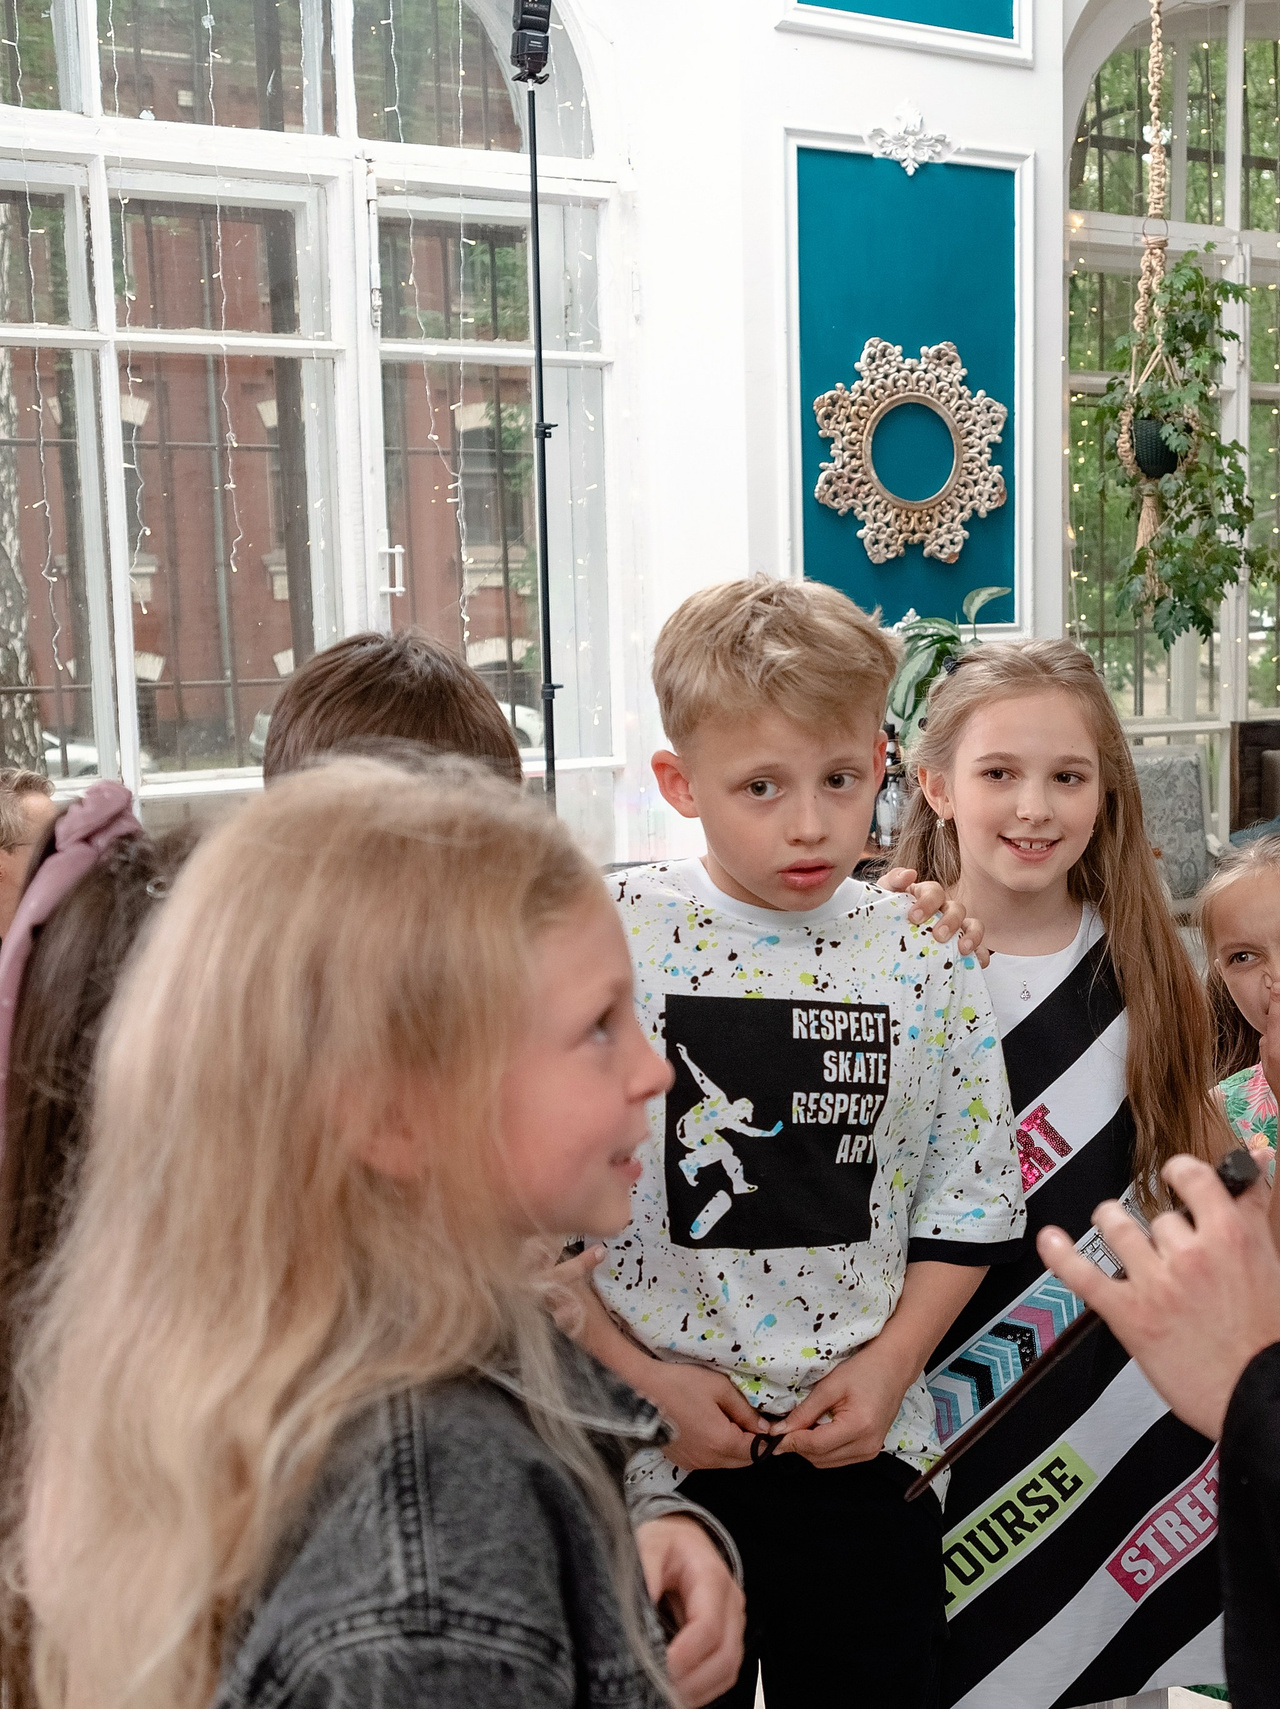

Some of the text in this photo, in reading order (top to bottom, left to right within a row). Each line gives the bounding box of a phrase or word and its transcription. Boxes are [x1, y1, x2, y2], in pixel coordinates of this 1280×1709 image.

[792, 1008, 886, 1043] RESPECT
[823, 1050, 887, 1084] SKATE
[792, 1092, 884, 1125] RESPECT
[1016, 1103, 1073, 1193] RT
[943, 1456, 1084, 1606] OURSE
